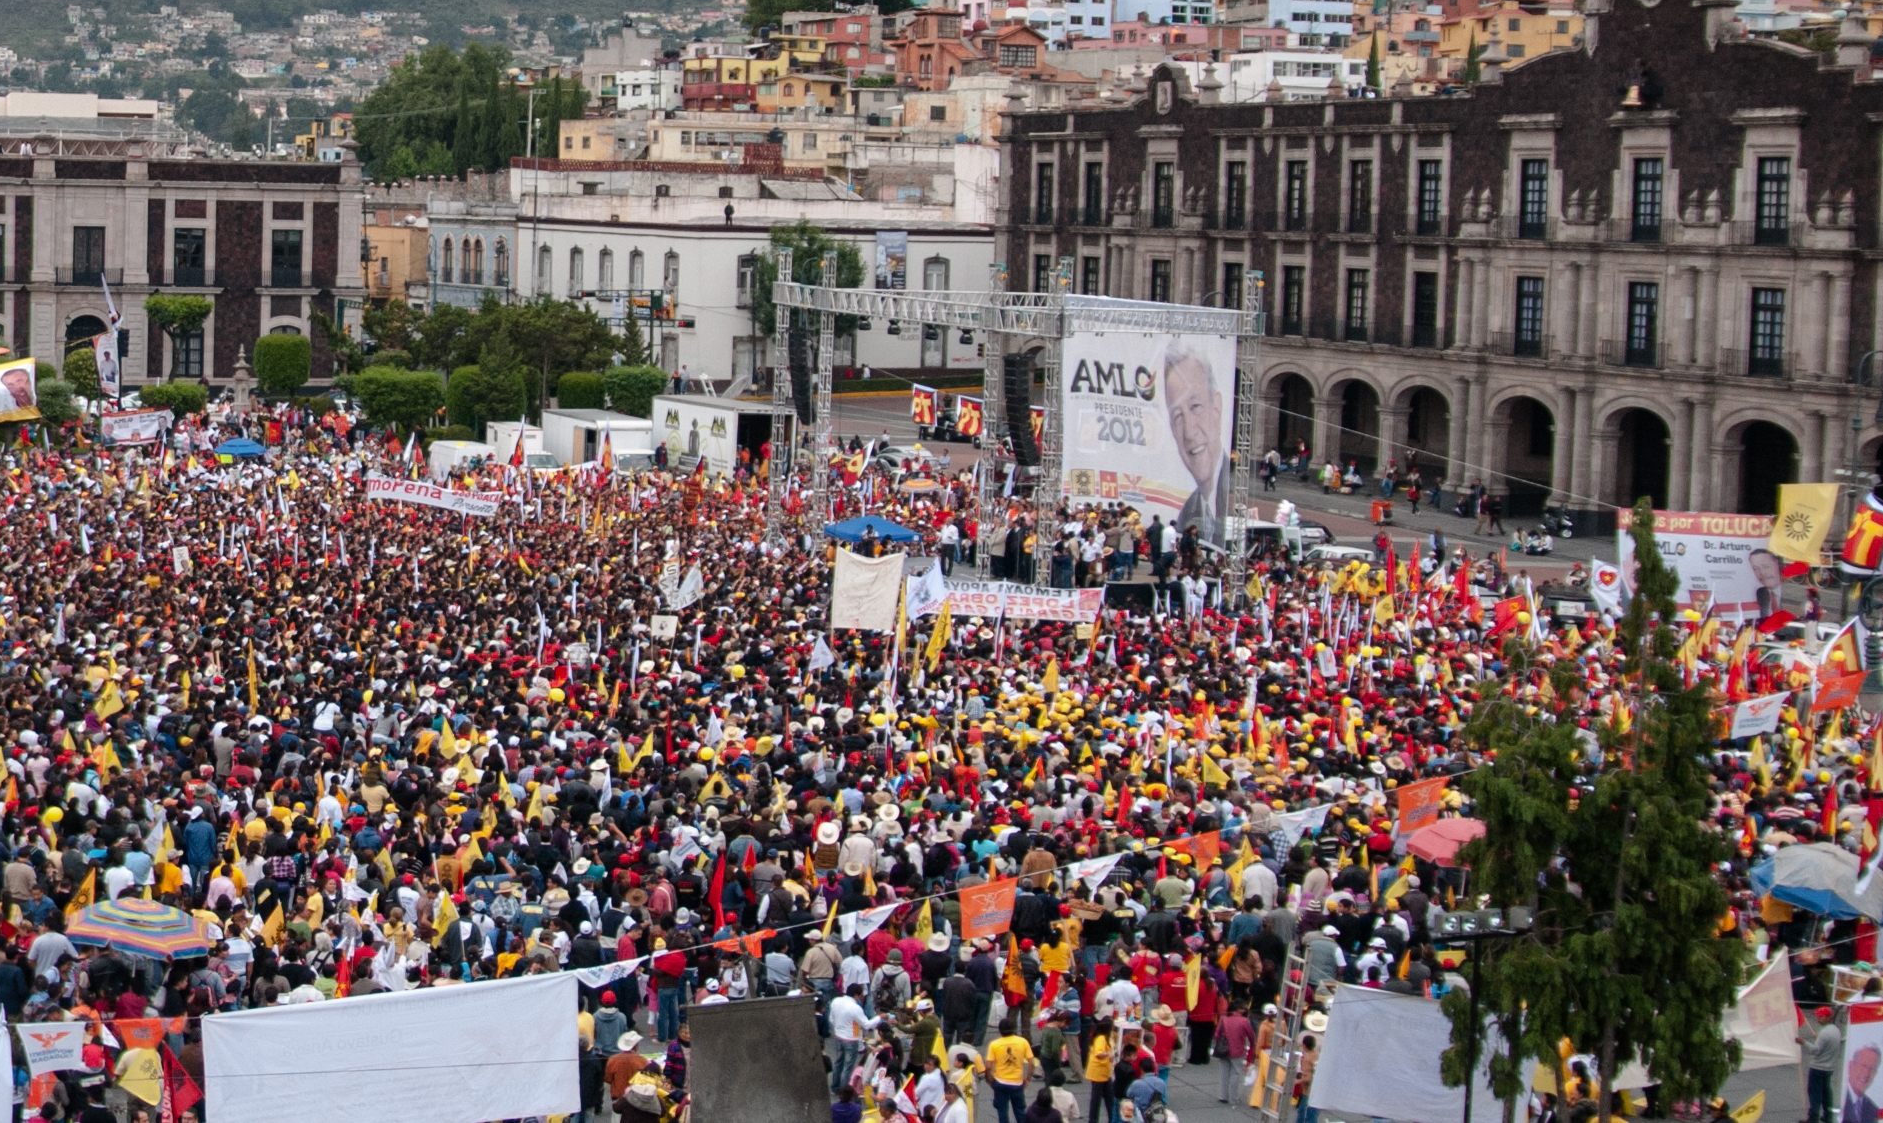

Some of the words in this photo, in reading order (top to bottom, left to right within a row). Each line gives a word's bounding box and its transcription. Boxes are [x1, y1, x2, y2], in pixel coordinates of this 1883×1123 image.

[1070, 358, 1157, 401] AMLO
[913, 391, 932, 424] PT
[1095, 402, 1143, 419] PRESIDENTE
[956, 401, 981, 436] PT
[1097, 415, 1147, 446] 2012
[368, 478, 442, 501] morena
[1101, 481, 1117, 497] PT
[1669, 518, 1695, 531] por
[1700, 516, 1775, 537] TOLUCA
[1657, 540, 1687, 557] MLO
[1703, 539, 1718, 551] Dr.
[1719, 540, 1753, 552] Arturo
[1705, 554, 1744, 565] Carrillo
